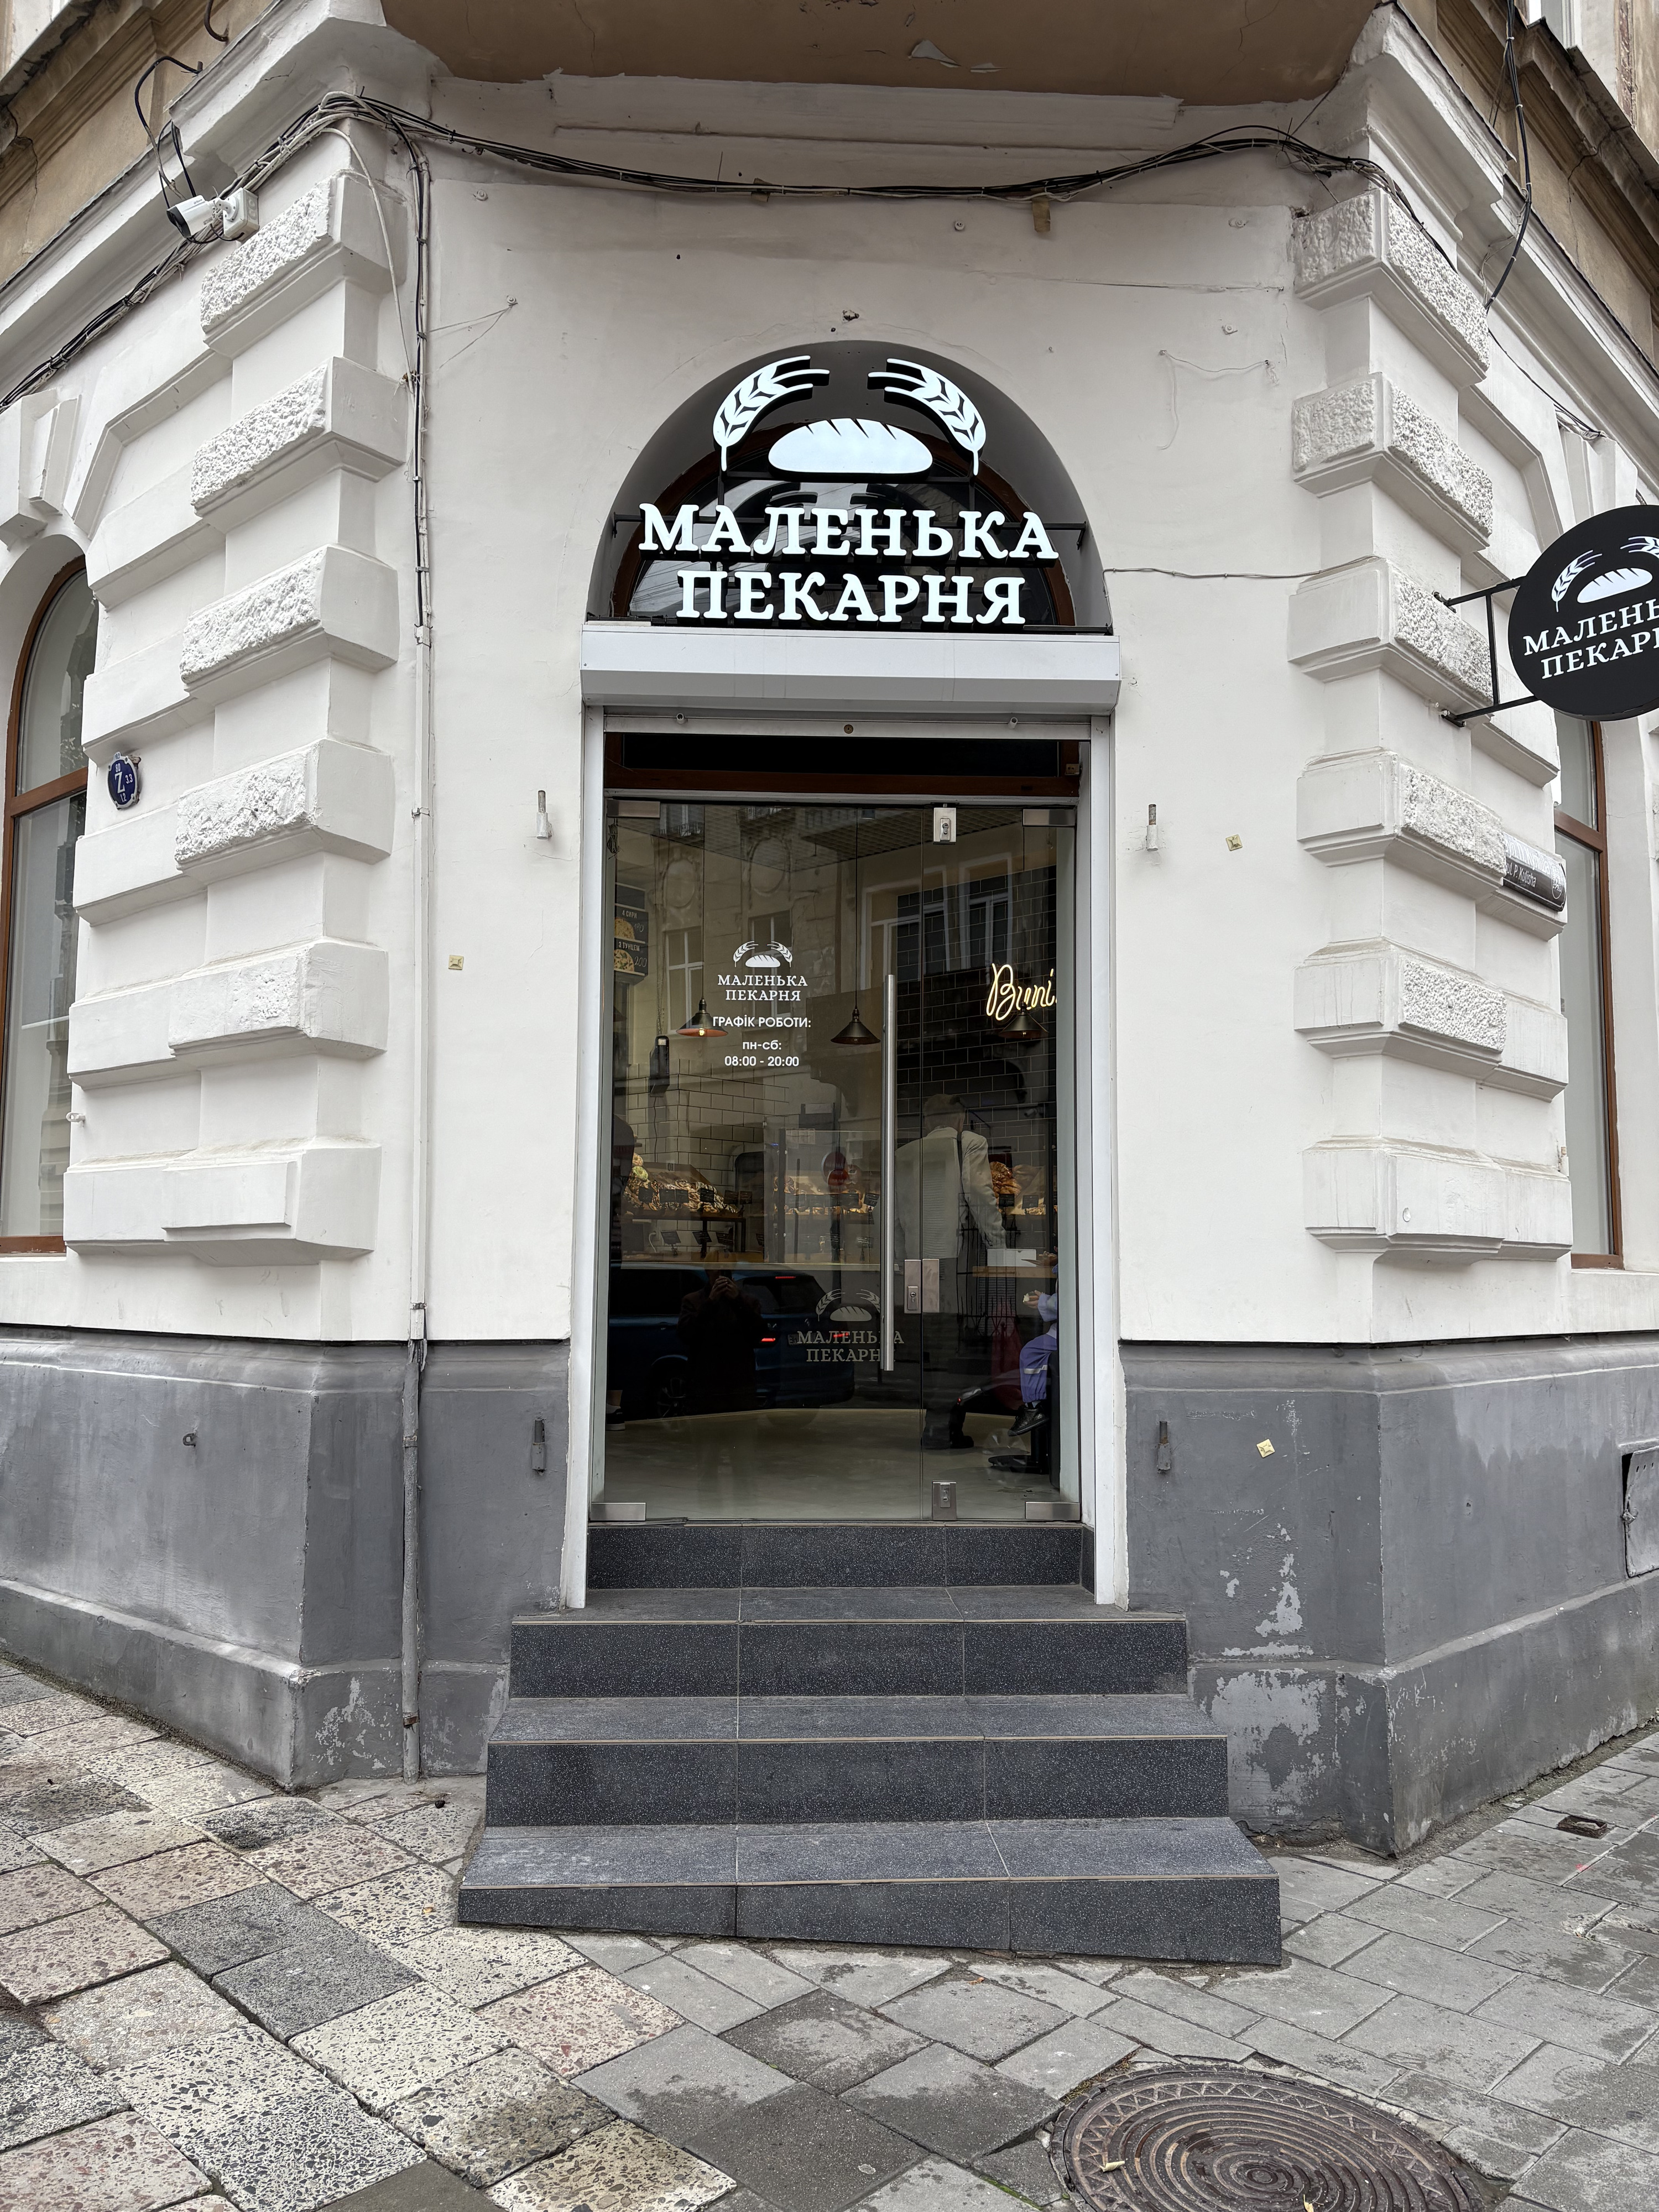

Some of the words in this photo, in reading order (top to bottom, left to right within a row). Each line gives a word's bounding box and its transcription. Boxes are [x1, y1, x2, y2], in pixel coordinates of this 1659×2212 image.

[638, 503, 1058, 559] МАЛЕНЬКА
[676, 570, 1025, 624] ПЕКАРНЯ
[114, 771, 125, 794] Z
[1519, 867, 1536, 887] Kulisha
[622, 942, 640, 952] ТУНЦЕМ
[634, 956, 647, 967] 200
[718, 974, 808, 987] МАЛЕНЬКА
[726, 990, 801, 1001] ПЕКАРНЯ
[758, 1017, 811, 1028] РОБОТИ:
[743, 1040, 781, 1050] пн-сб:
[724, 1056, 757, 1066] 08:00
[768, 1056, 799, 1067] 20:00
[797, 1331, 905, 1344] МАЛЕНЬА
[806, 1349, 895, 1362] ПЕКАРН
